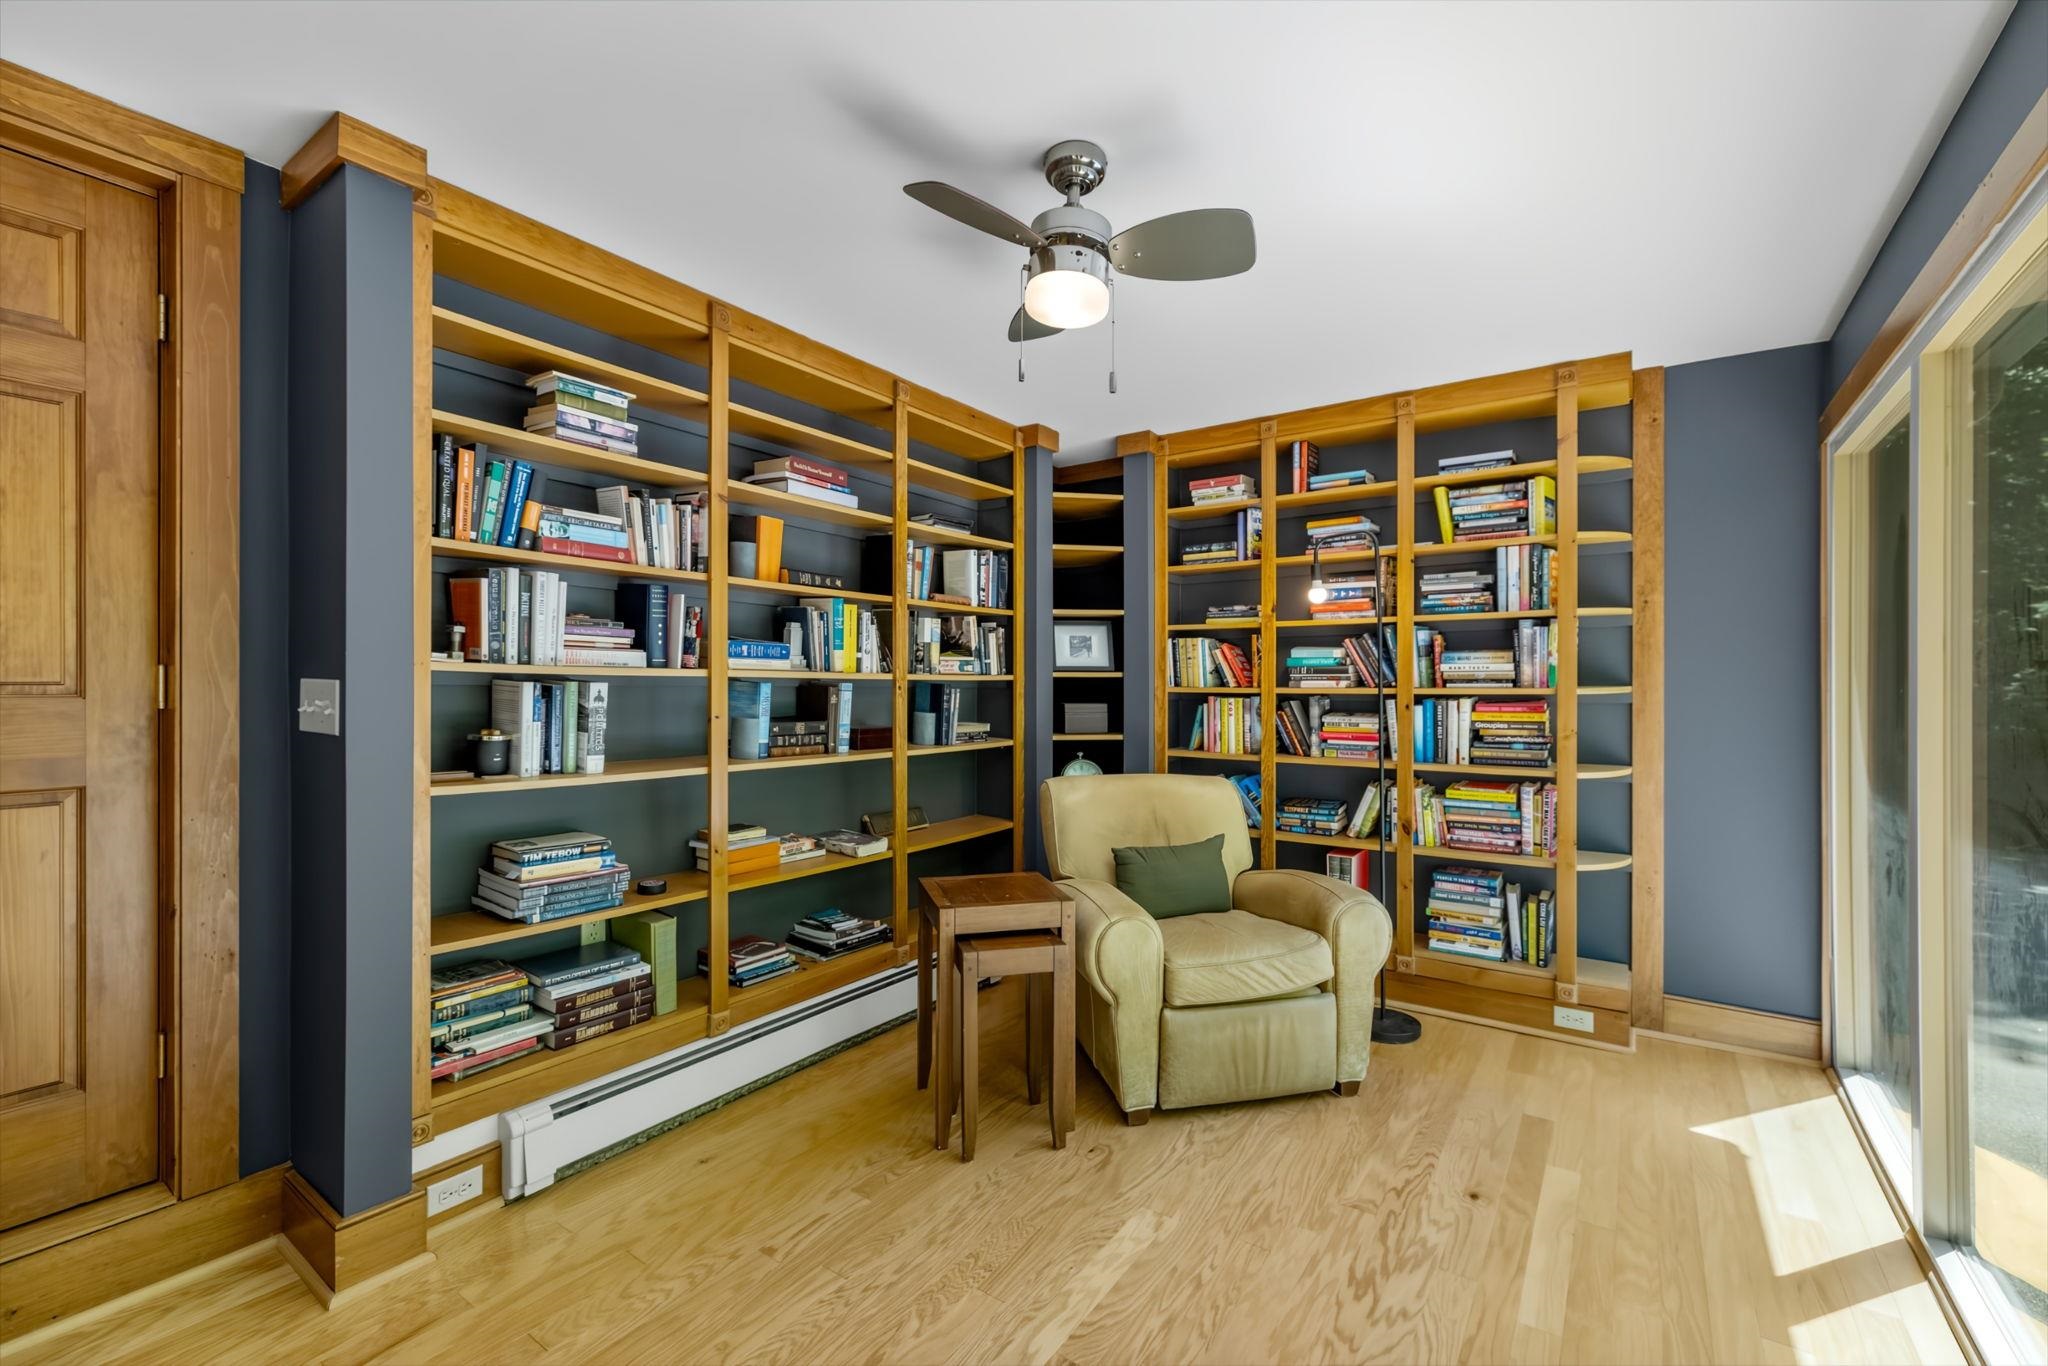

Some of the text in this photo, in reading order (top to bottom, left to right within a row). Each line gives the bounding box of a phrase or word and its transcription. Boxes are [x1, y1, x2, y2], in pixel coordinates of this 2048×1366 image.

[596, 708, 604, 751] POLITICS
[523, 847, 582, 862] TIM TEBOW
[552, 968, 590, 983] ENCYCLOPEDIA
[576, 988, 614, 1006] HANDBOOK
[580, 1002, 618, 1020] HANDBOOK
[576, 1021, 614, 1040] HANDBOOK
